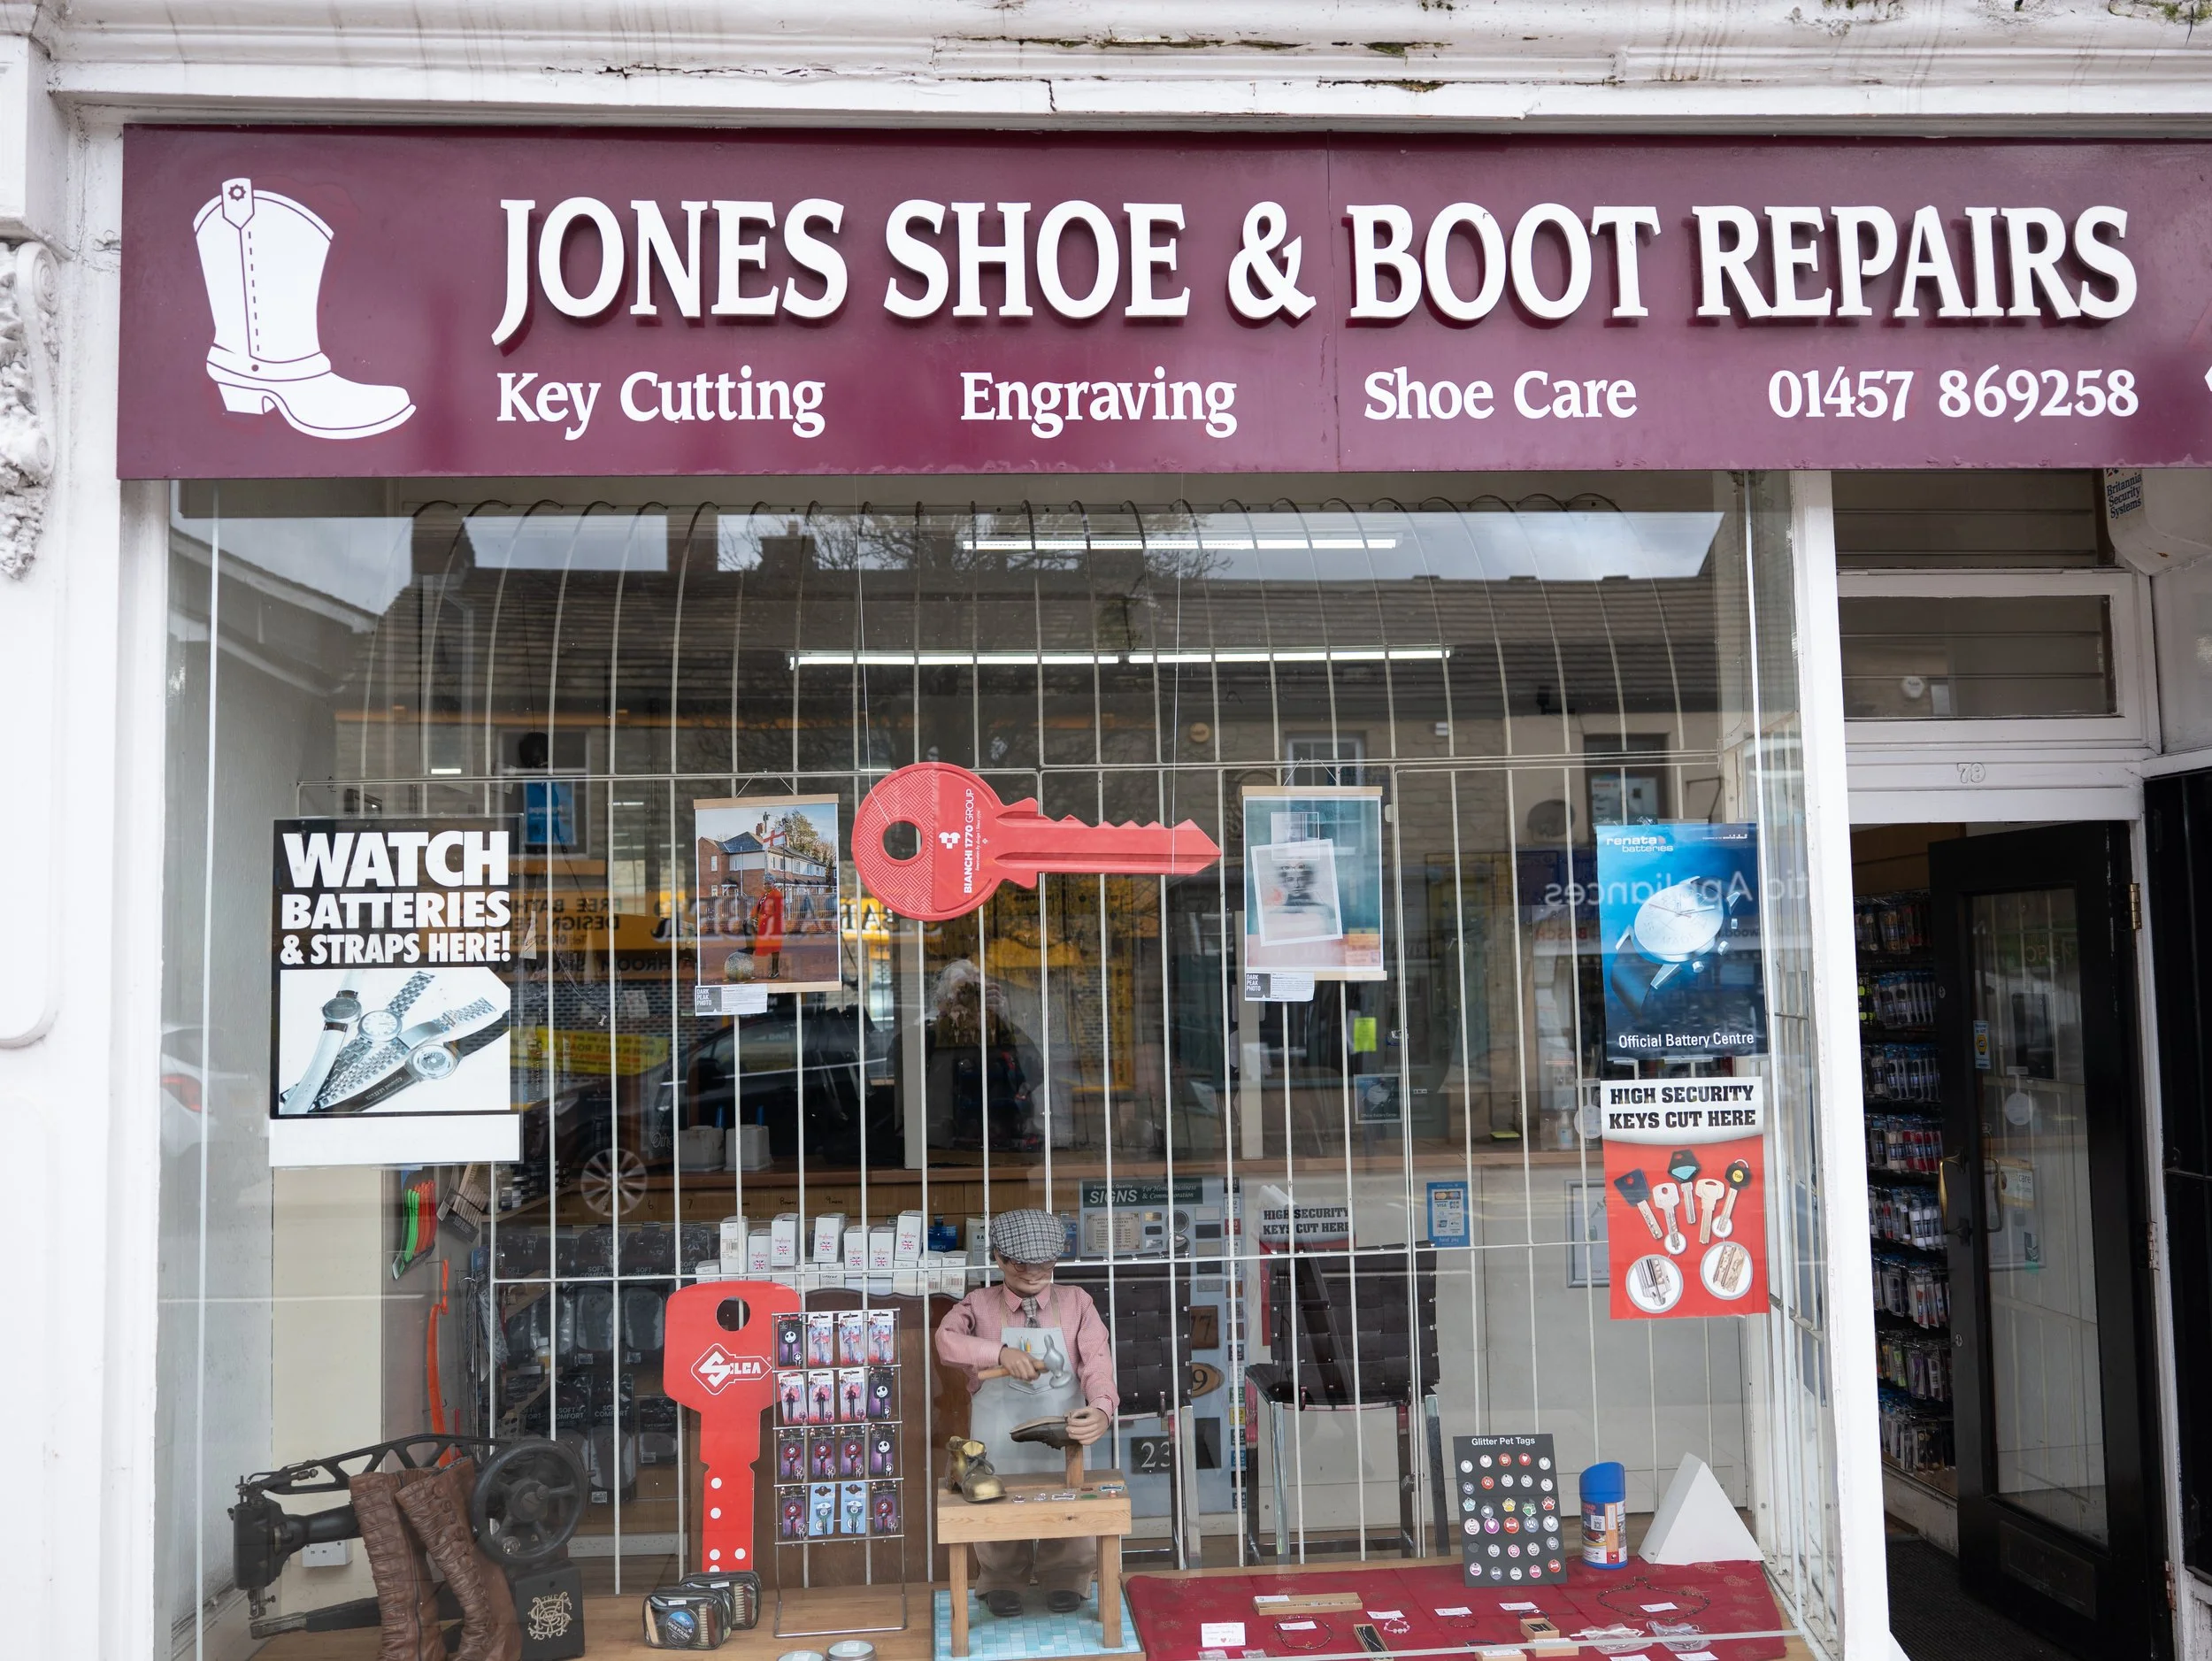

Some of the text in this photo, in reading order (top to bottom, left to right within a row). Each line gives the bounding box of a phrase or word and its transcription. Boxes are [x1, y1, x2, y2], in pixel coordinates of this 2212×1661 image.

[492, 197, 2137, 345] JONES SHOE & BOOT REPAIRS
[497, 365, 2139, 441] Key Cutting Engraving Shoe Care 01457 869258
[2107, 473, 2141, 496] Britannia
[2108, 486, 2140, 507] Security
[2110, 498, 2141, 519] Systems
[964, 788, 974, 894] BIANCHI 1770 GROUP
[1606, 835, 1658, 846] renata
[283, 830, 510, 888] WATCH
[281, 890, 511, 931] BATTERIES
[280, 930, 511, 965] & STRAPS HERE!
[1618, 1031, 1755, 1049] Official Battery Centre
[1610, 1085, 1754, 1105] HIGH SECURITY
[1609, 1109, 1756, 1130] KEYS CUT HERE
[1263, 1207, 1348, 1220] HIGH SECURITY
[1263, 1224, 1289, 1235] KEYS
[1296, 1223, 1319, 1234] CUT
[698, 1350, 761, 1388] SILCA
[1515, 1436, 1536, 1446] Tags
